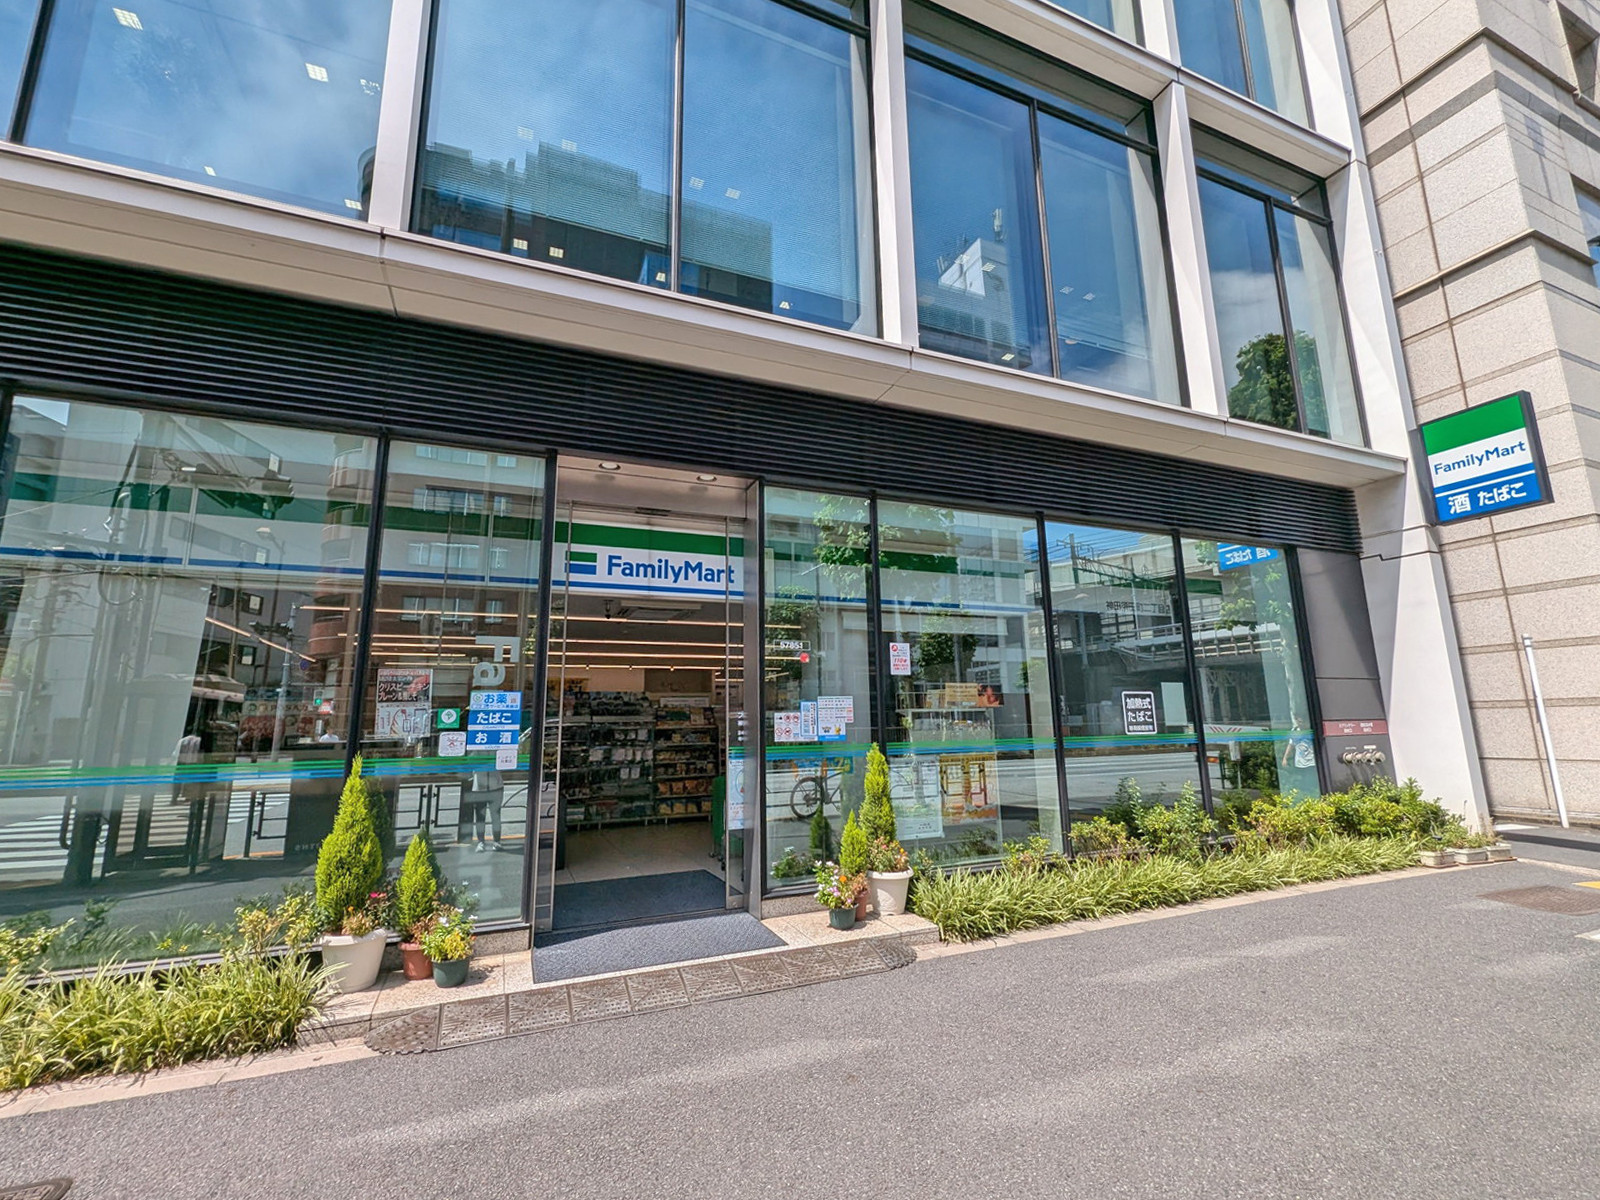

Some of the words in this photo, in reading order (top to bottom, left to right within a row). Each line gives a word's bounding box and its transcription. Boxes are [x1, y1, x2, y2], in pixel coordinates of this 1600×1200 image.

[1434, 441, 1526, 475] FamilyMart
[1448, 493, 1471, 514] 酒
[1477, 482, 1527, 506] たばこ
[607, 554, 735, 583] FamilyMart
[476, 712, 512, 724] たばこ
[1127, 711, 1153, 722] たばこ
